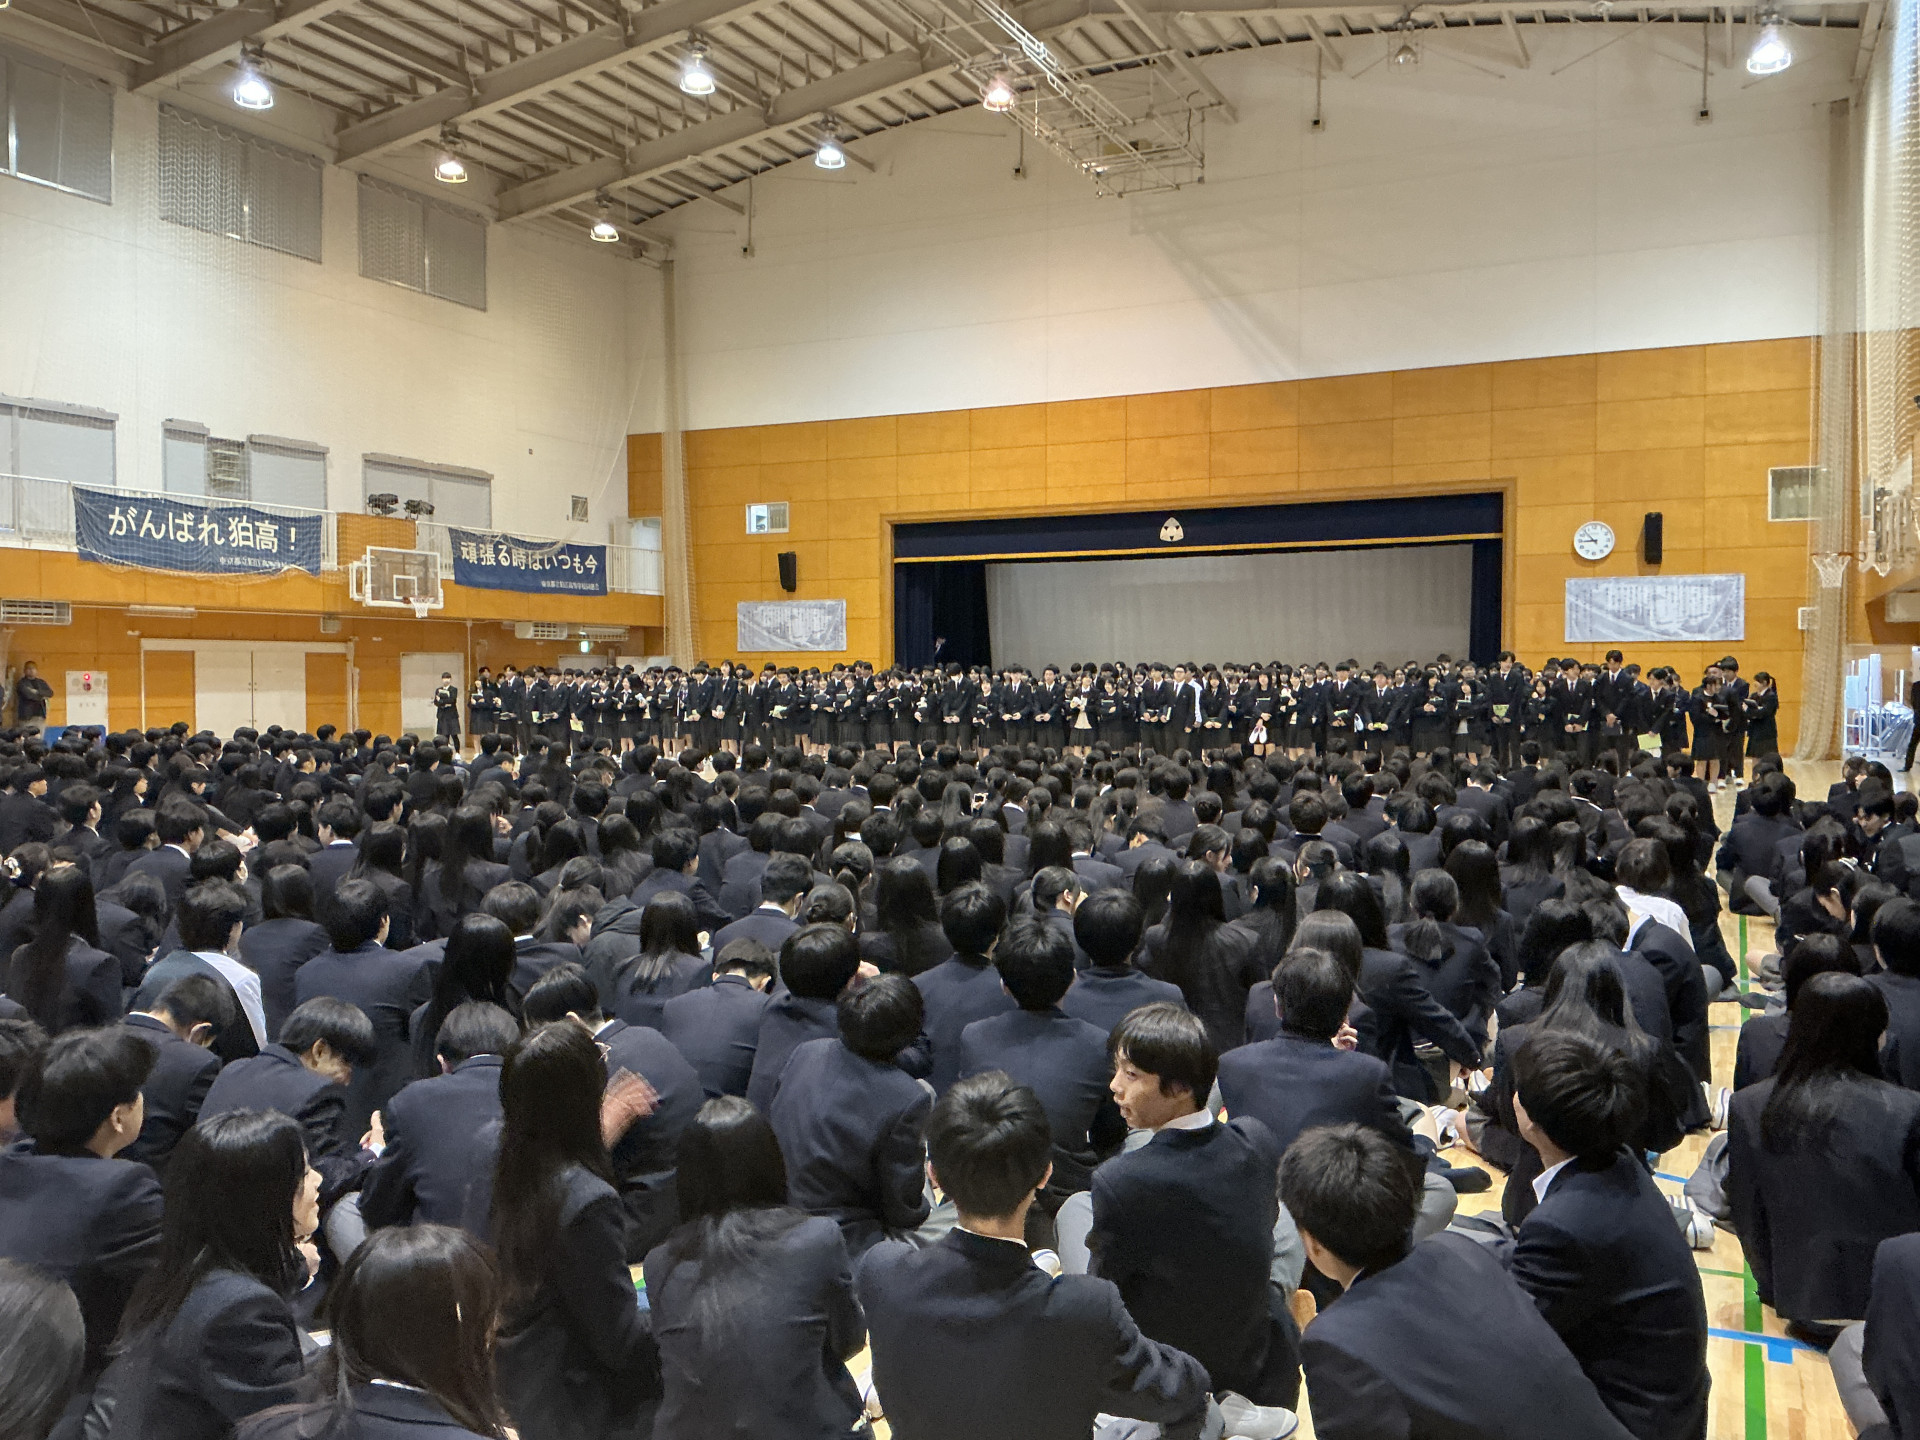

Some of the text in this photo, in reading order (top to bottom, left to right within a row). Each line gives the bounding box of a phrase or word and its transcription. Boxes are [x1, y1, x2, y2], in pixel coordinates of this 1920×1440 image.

[108, 506, 296, 553] がんばれ狛高！
[460, 541, 598, 574] 頑張る時はいつも今
